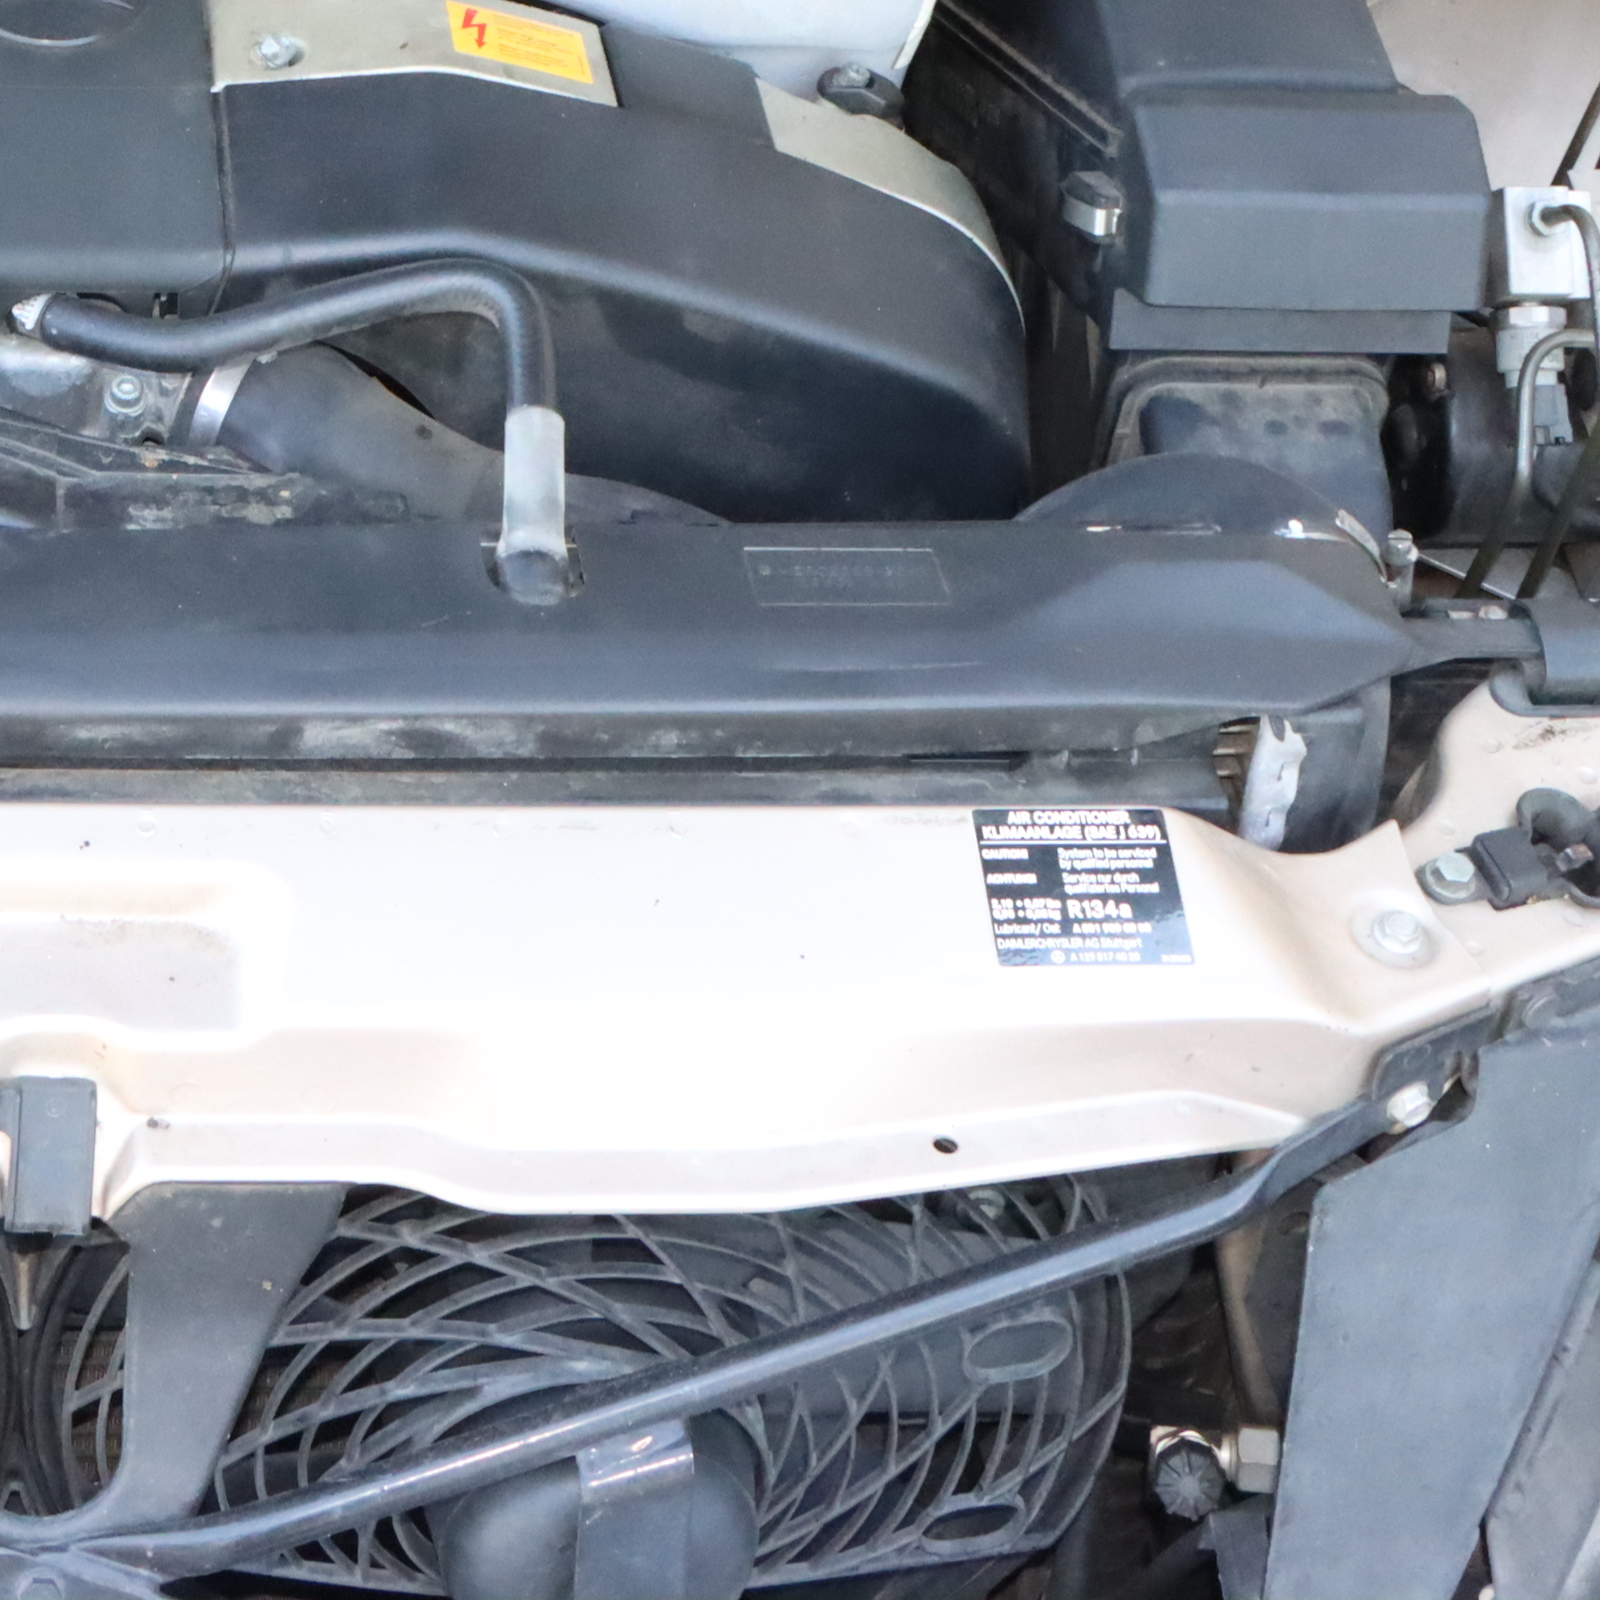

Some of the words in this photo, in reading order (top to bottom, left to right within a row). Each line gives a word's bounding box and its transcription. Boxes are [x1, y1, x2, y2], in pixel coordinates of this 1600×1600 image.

[1008, 811, 1031, 824] AIR
[1033, 811, 1130, 824] CONDITIONER
[982, 826, 1082, 839] KLIMAANLAGE
[1085, 826, 1117, 841] (SAE
[1128, 825, 1161, 841] 639)
[1058, 848, 1092, 859] System
[1093, 848, 1104, 858] to
[1104, 848, 1117, 858] be
[1118, 848, 1157, 858] serviced
[1059, 859, 1072, 870] by
[1073, 859, 1109, 869] qualified
[1110, 859, 1153, 869] personnel
[1063, 873, 1096, 883] Service
[1097, 875, 1111, 883] nur
[1113, 873, 1139, 883] durch
[1121, 884, 1159, 893] Personal
[1066, 900, 1132, 918] R134a
[997, 938, 1084, 949] DAIMLERCHRYSLER
[1085, 938, 1099, 948] AG
[1100, 937, 1142, 950] Stuttgart
[1070, 952, 1078, 961] A
